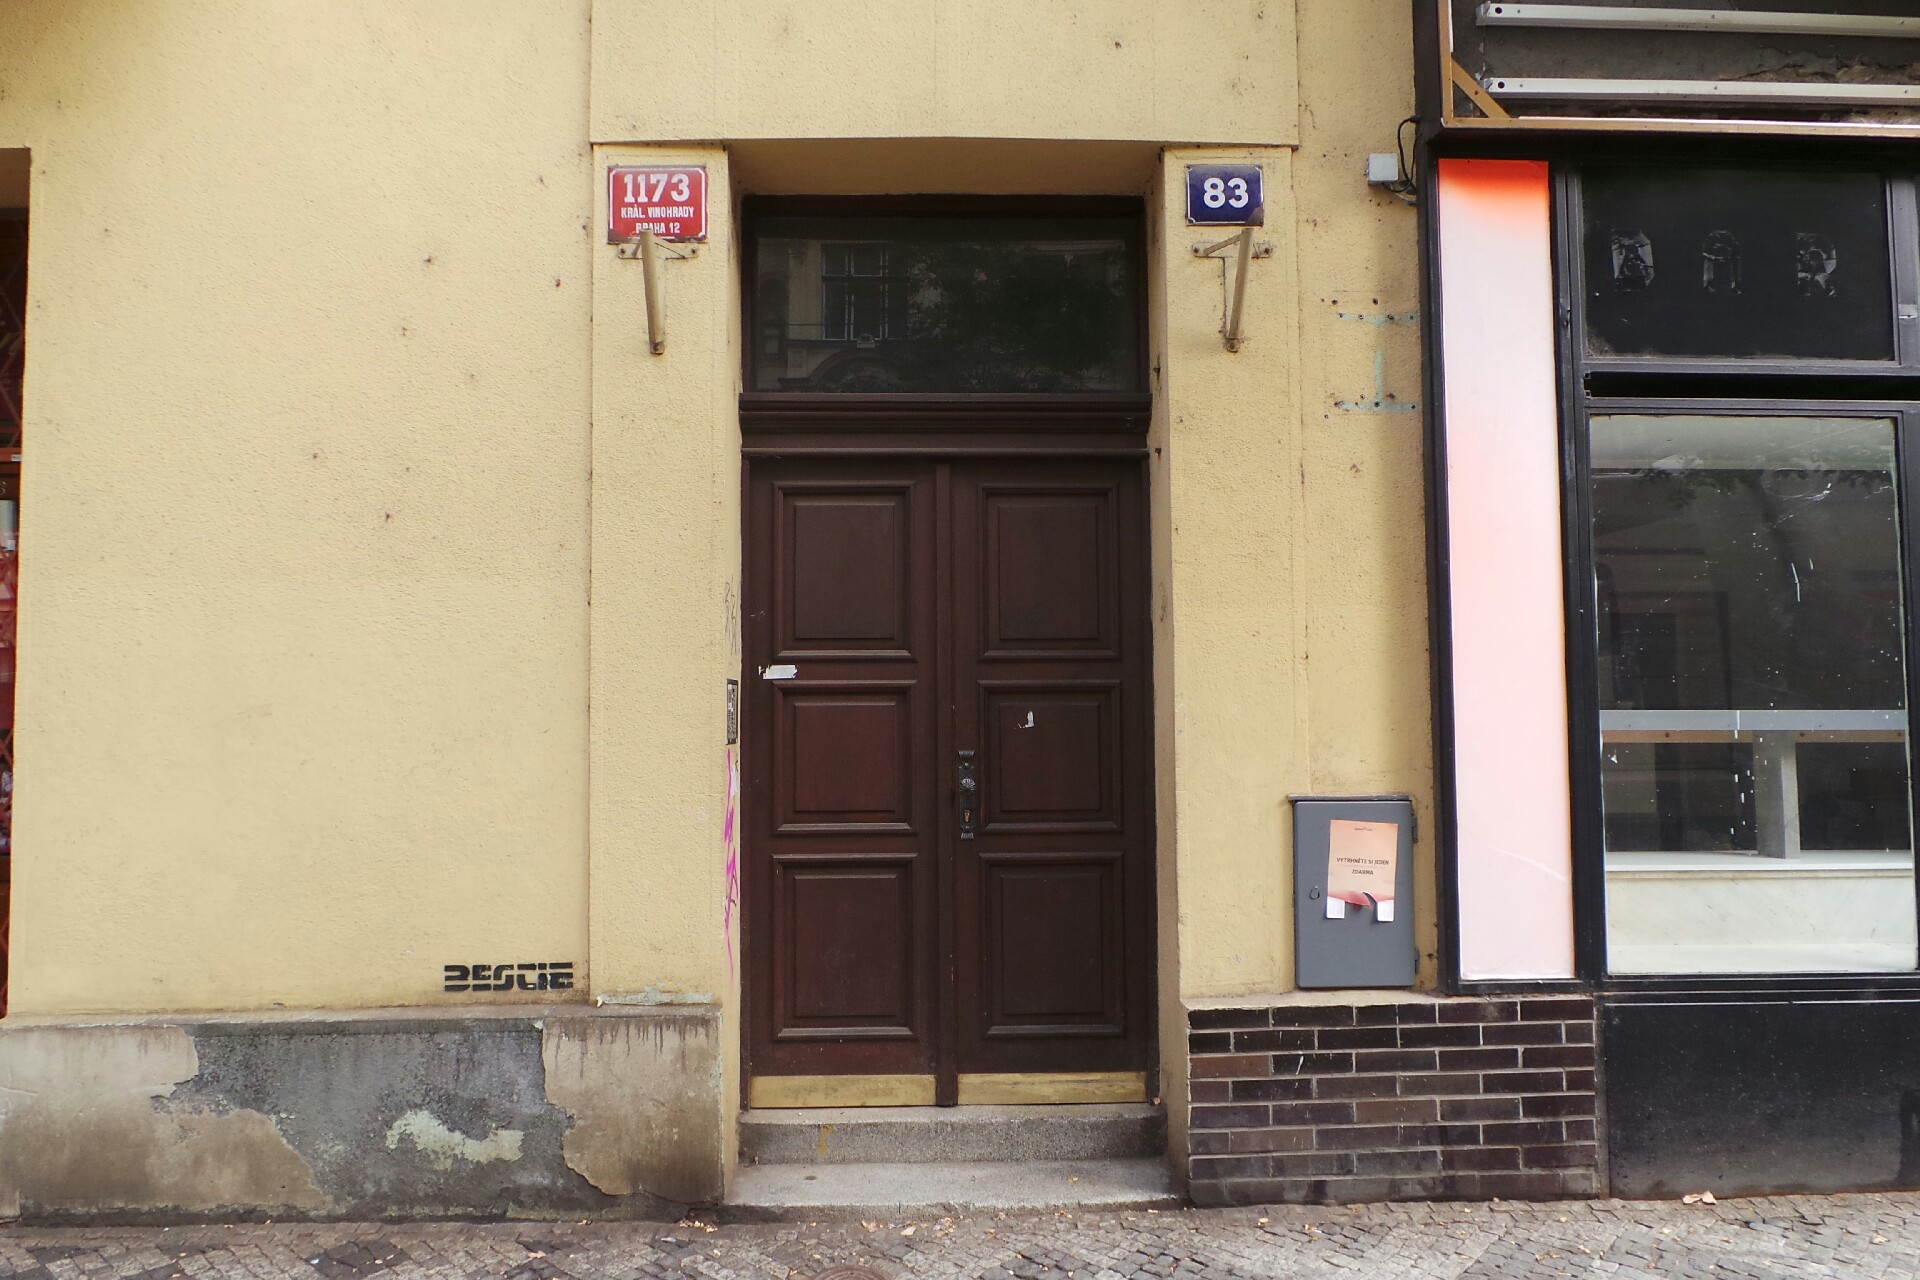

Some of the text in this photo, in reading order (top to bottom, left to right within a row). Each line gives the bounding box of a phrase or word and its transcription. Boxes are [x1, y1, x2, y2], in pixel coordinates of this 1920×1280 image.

[624, 173, 690, 203] 1173
[1203, 177, 1249, 209] 83
[647, 206, 694, 218] VINOHRADY
[669, 222, 681, 234] 12
